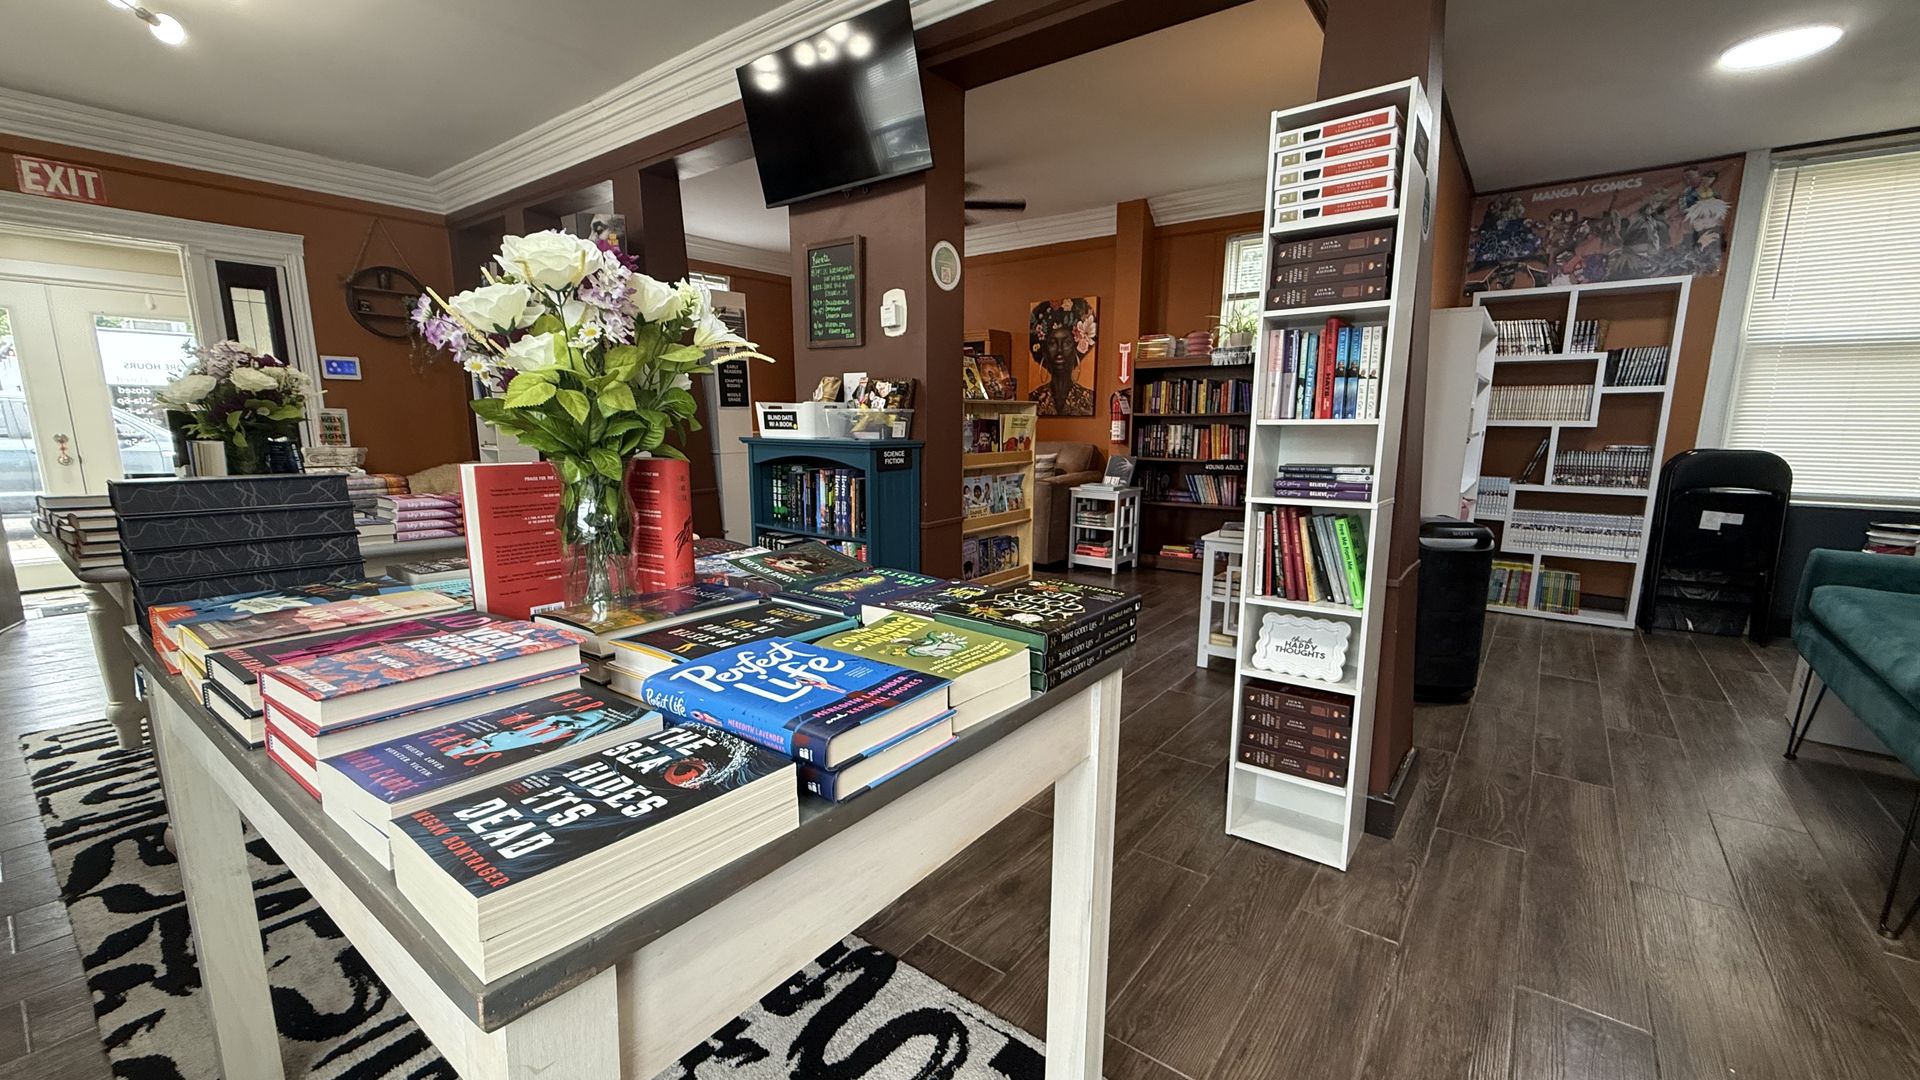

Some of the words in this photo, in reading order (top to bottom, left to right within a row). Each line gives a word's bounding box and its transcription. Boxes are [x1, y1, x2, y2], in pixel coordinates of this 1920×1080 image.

[20, 159, 98, 199] EXIT
[1532, 187, 1579, 202] MANGA
[1591, 178, 1643, 194] COMICS
[884, 450, 905, 458] SCIENCE
[1341, 536, 1348, 546] Me
[873, 569, 936, 583] DEVOTED
[463, 628, 545, 649] VERY
[668, 629, 713, 643] SISTER
[697, 624, 739, 638] GOING
[714, 640, 737, 648] MY
[832, 616, 914, 648] CONJURING
[864, 621, 929, 648] AMERICA
[1061, 630, 1074, 642] THESE
[1088, 621, 1097, 632] LIES
[403, 640, 480, 662] EPISODE
[432, 634, 504, 657] SPECIAL
[1058, 649, 1072, 662] THESE
[1085, 638, 1094, 648] LIES
[1276, 645, 1326, 660] THOUGHTS
[1285, 641, 1318, 651] HAPPY
[670, 641, 818, 692] Perfect
[733, 655, 845, 704] Life
[1060, 669, 1073, 681] THESE
[1086, 658, 1094, 668] LIES
[550, 692, 604, 712] HER
[645, 687, 668, 711] Perfect
[668, 692, 687, 718] Life
[812, 697, 864, 718] MEREDITH
[864, 675, 908, 699] LAVENDER
[826, 714, 848, 725] and
[846, 692, 888, 717] KENDALL
[888, 678, 923, 698] SHORES
[498, 712, 576, 744] MANY
[728, 719, 755, 734] MEREDITH
[755, 728, 784, 745] LAVENDER
[418, 726, 502, 766] FACES
[648, 727, 718, 757] THE
[602, 742, 672, 774] SEA
[563, 762, 669, 818] HIDES
[520, 786, 597, 828] ITS
[412, 810, 450, 837] MEGAN
[453, 798, 556, 860] DEAD
[442, 828, 510, 889] BONTRAGER
